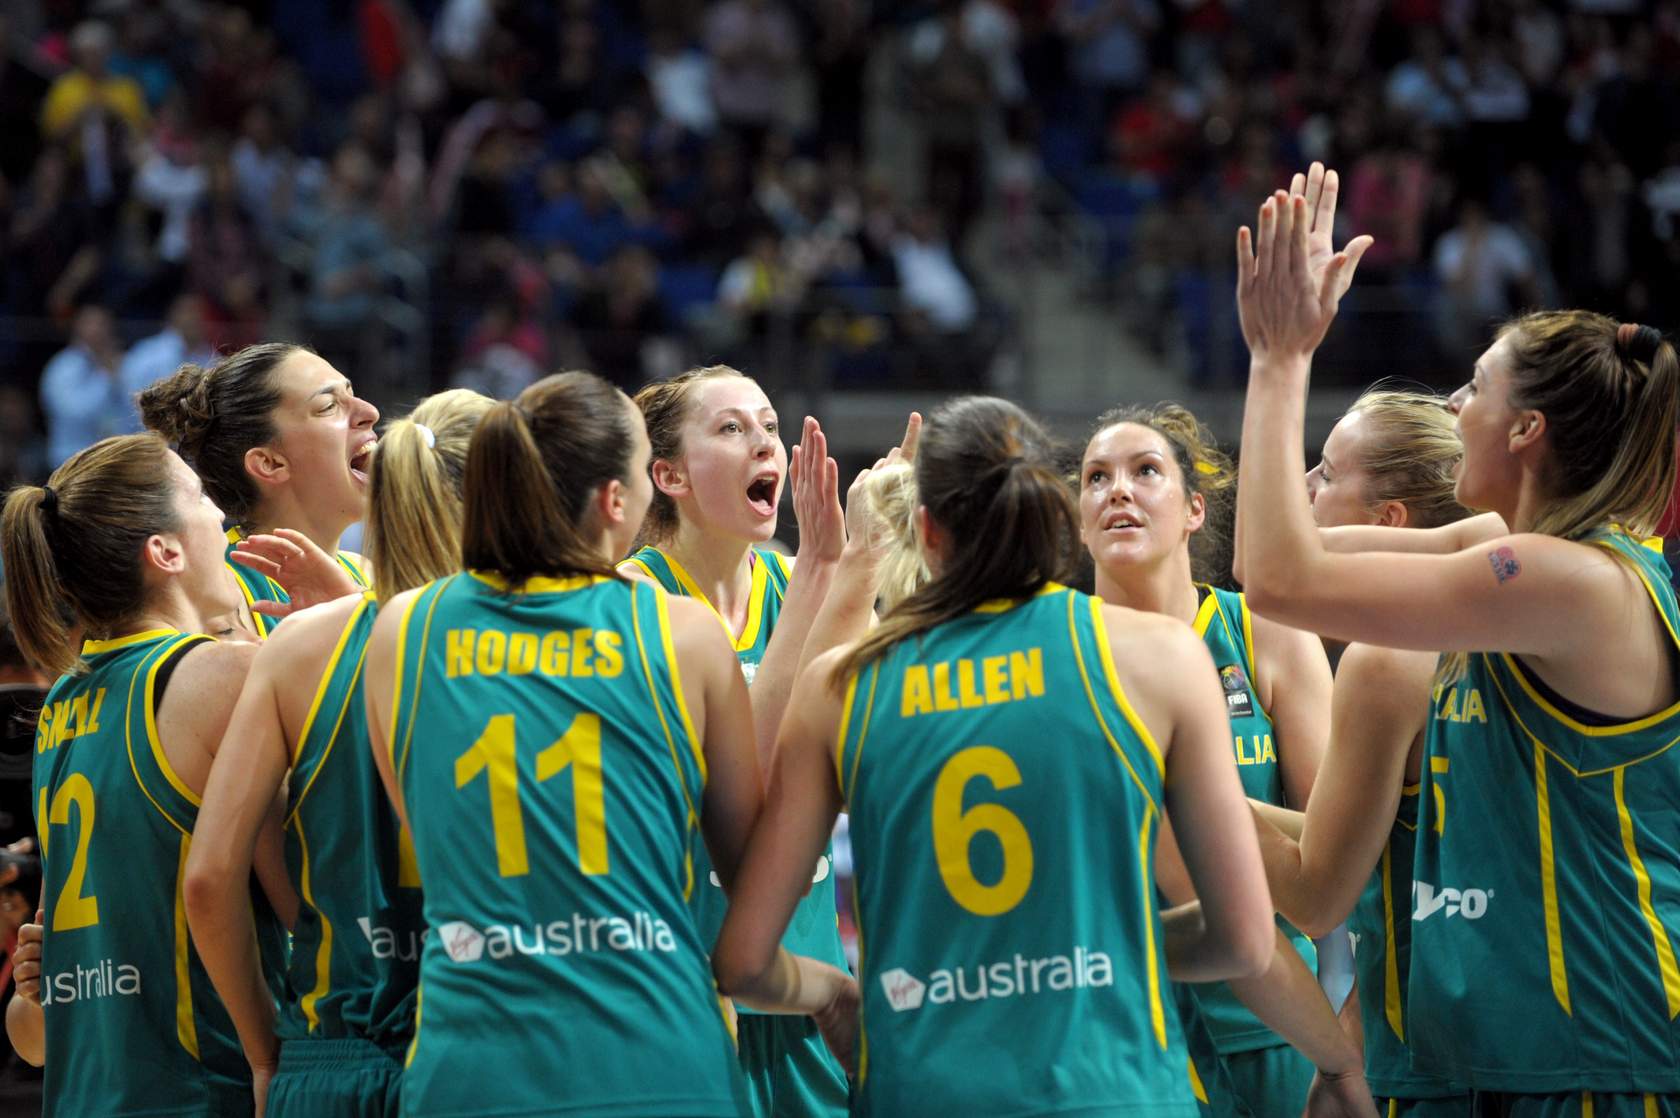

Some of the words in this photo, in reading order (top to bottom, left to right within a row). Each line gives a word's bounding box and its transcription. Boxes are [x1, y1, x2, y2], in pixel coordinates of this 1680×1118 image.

[445, 628, 625, 679] HODGES
[900, 647, 1046, 718] ALLEN
[1227, 693, 1249, 705] FIBA
[454, 712, 610, 878] 11
[931, 745, 1034, 917] 6
[485, 912, 678, 958] australia
[928, 946, 1113, 1004] australia
